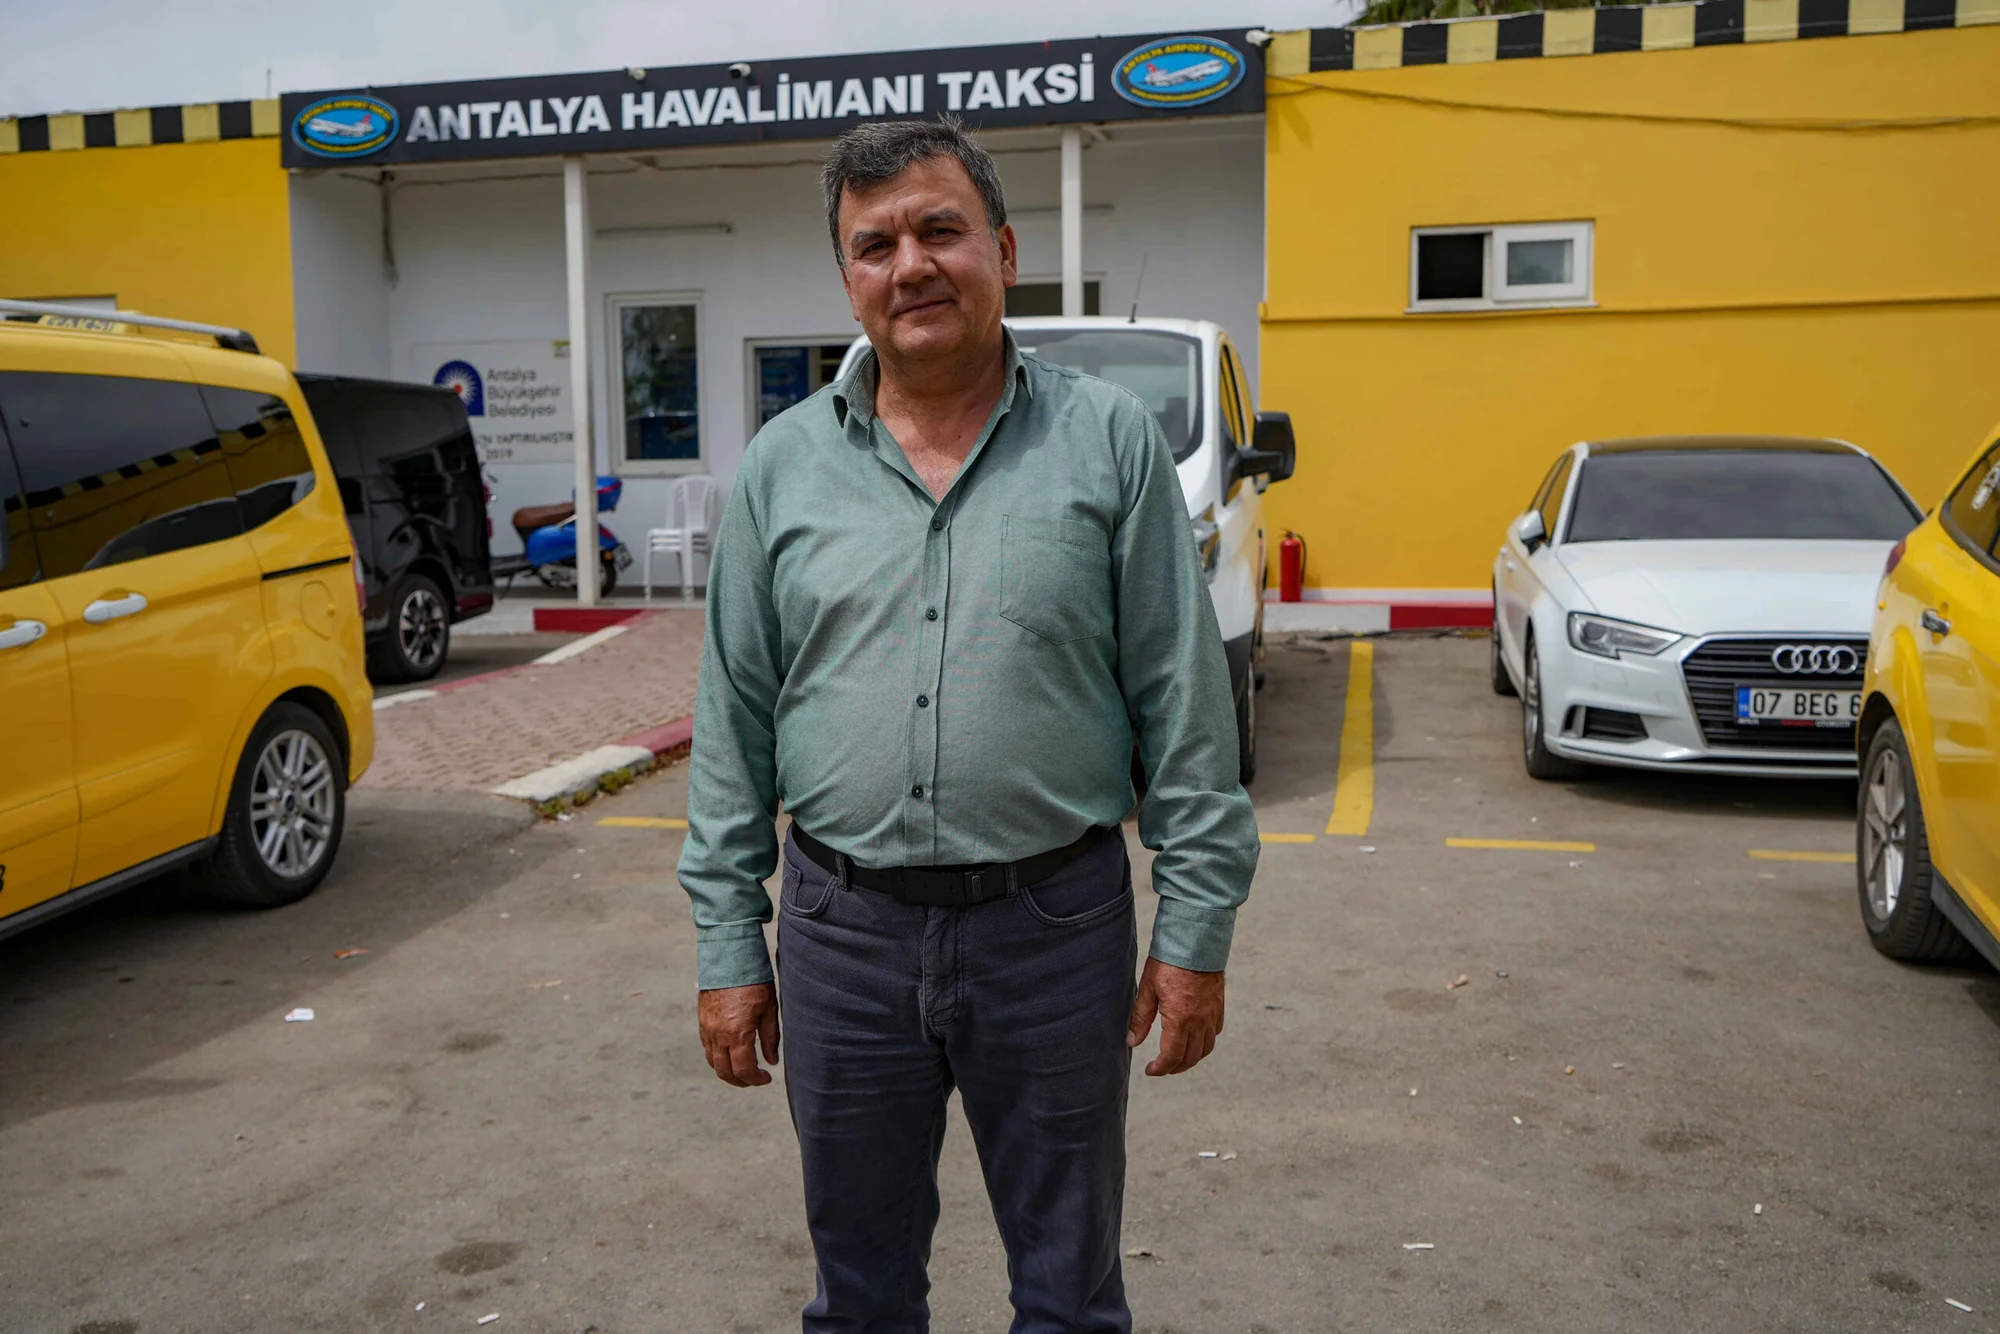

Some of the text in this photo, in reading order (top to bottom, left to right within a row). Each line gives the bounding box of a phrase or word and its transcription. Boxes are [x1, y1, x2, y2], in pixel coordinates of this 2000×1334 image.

[405, 53, 1095, 143] ANTALYA HAVALİMANI TAKSİ
[487, 368, 537, 383] Antalya
[487, 386, 561, 402] Büyükşehir
[488, 404, 557, 419] Belediyesi
[486, 449, 514, 460] 2019
[1752, 692, 1782, 715] 07
[1794, 693, 1838, 717] BEG
